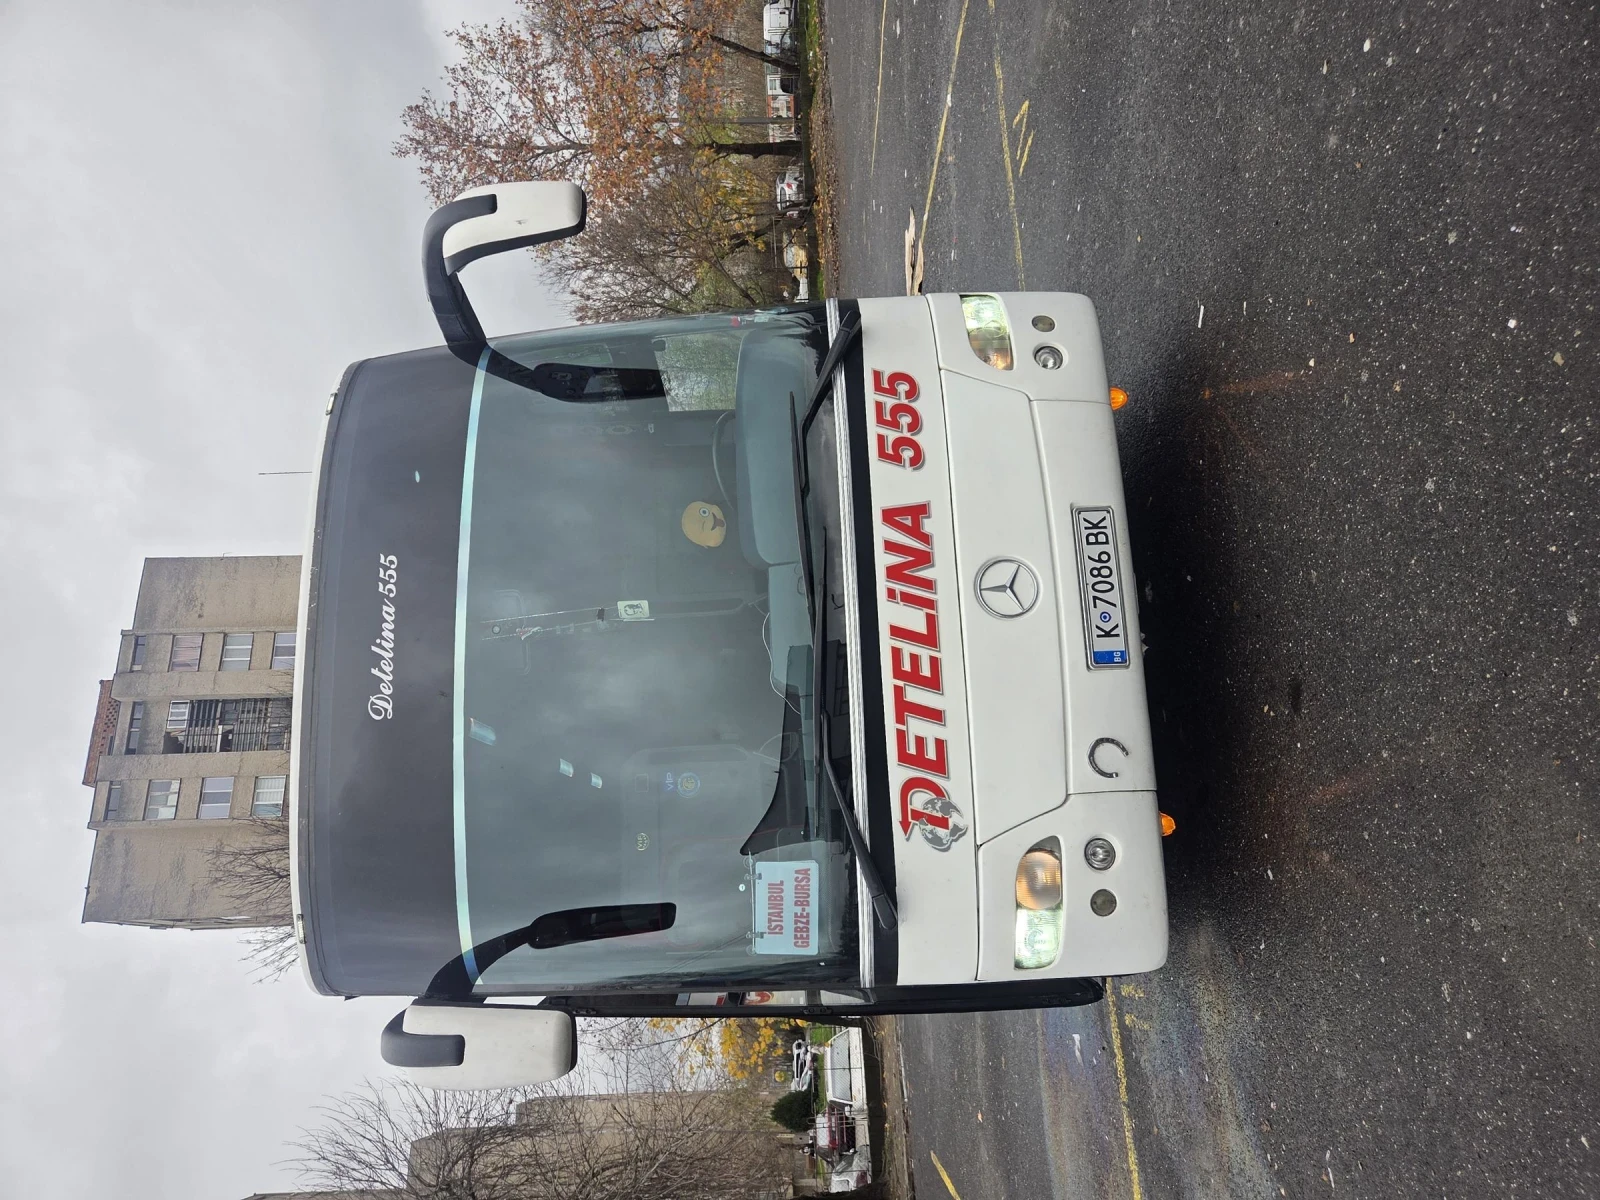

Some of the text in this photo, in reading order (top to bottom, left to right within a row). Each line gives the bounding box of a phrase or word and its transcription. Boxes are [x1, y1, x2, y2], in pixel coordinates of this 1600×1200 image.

[871, 368, 924, 471] 555
[1082, 515, 1120, 638] K 7086 BK
[368, 553, 398, 720] Detelina 555
[1113, 651, 1121, 662] BG
[793, 868, 811, 948] GEBZE-BURSA
